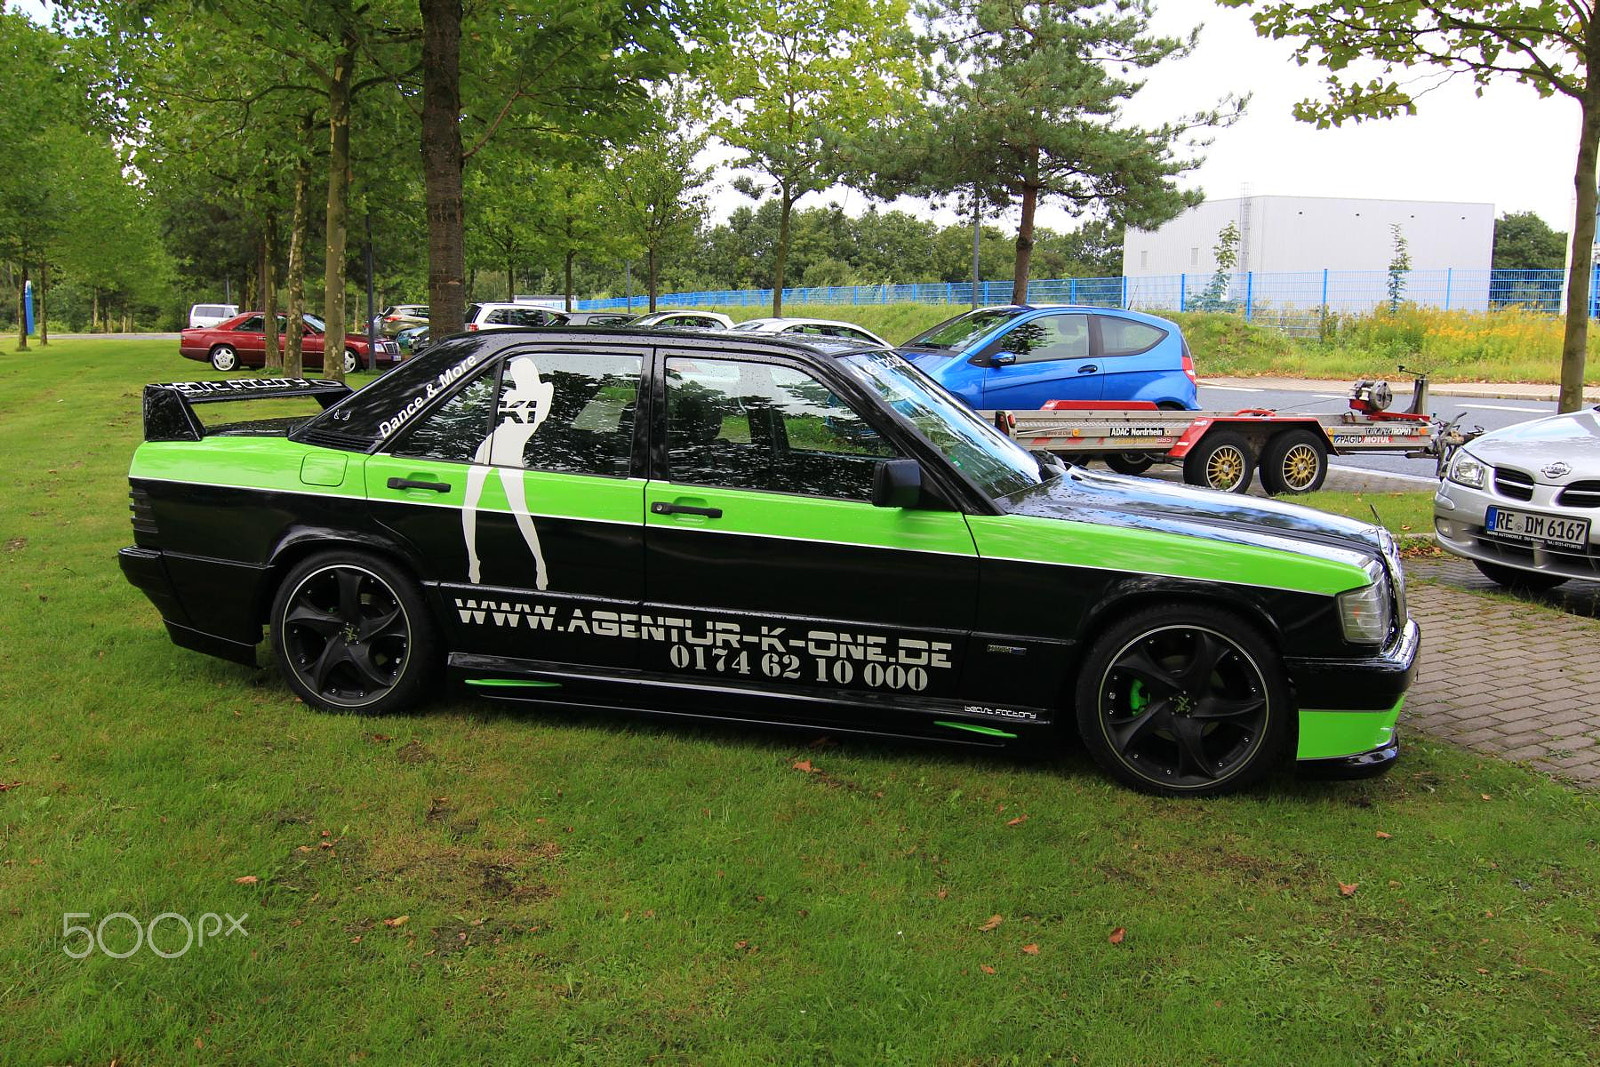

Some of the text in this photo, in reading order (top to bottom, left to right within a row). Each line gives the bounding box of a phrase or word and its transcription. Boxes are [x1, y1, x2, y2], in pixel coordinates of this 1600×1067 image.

[378, 353, 478, 439] Dance & More
[1110, 427, 1163, 437] ADAC Nordrhein
[1363, 435, 1389, 444] MOTUL
[1496, 511, 1586, 541] RE DM 6167
[455, 595, 952, 670] WWW.AGENTUR-K-ONE.DE
[670, 644, 929, 692] 0174 62 10 000
